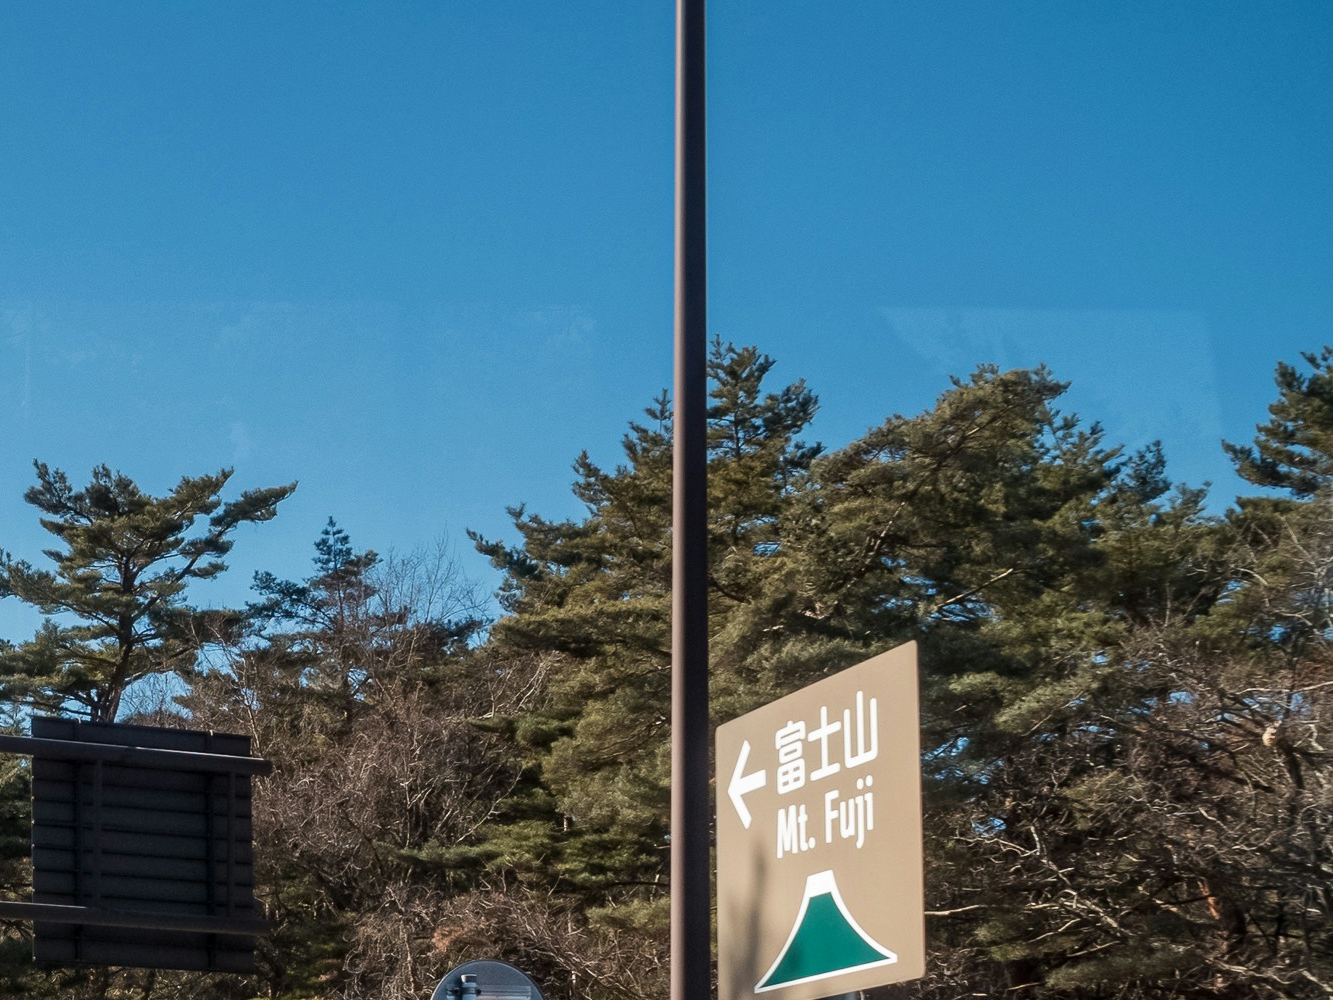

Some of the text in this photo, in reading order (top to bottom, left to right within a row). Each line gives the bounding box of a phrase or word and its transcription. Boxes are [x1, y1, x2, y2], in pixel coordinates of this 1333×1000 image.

[775, 690, 878, 795] 富士山
[776, 775, 874, 859] Mt. Fuji
